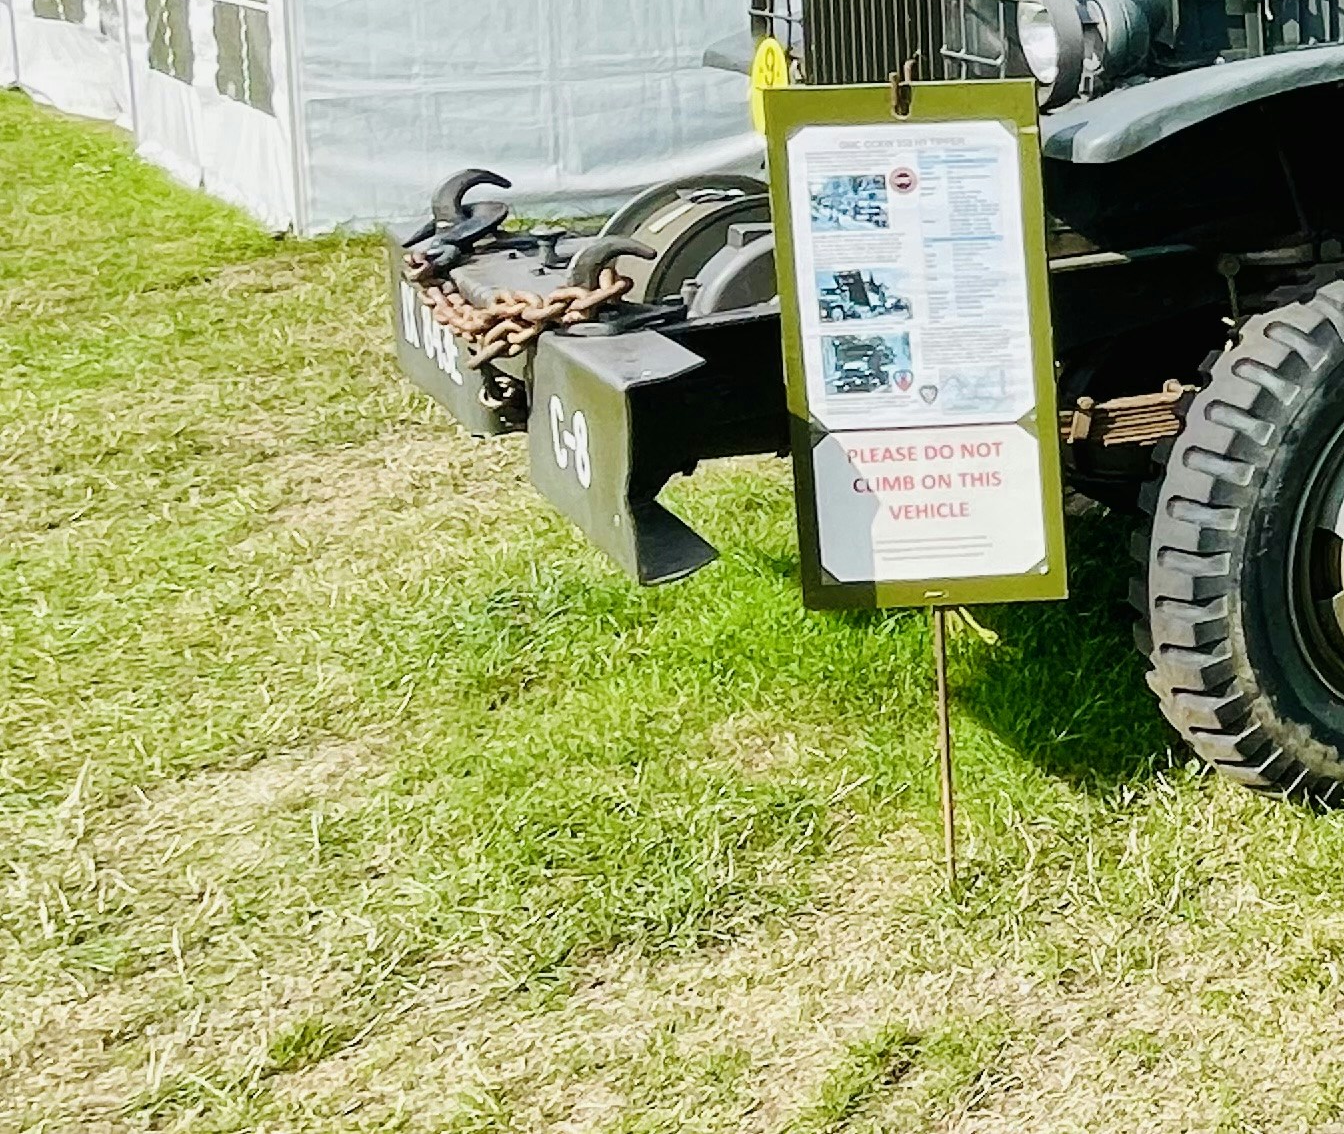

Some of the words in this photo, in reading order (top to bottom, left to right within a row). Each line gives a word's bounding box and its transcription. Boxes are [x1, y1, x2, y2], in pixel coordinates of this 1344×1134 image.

[549, 393, 592, 489] C-8
[847, 445, 918, 464] PLEASE
[924, 444, 954, 460] DO
[961, 441, 1003, 459] NOT
[853, 475, 915, 493] CLIMB
[921, 473, 952, 490] ON
[958, 470, 1002, 488] THIS
[888, 501, 970, 521] VEHICLE
